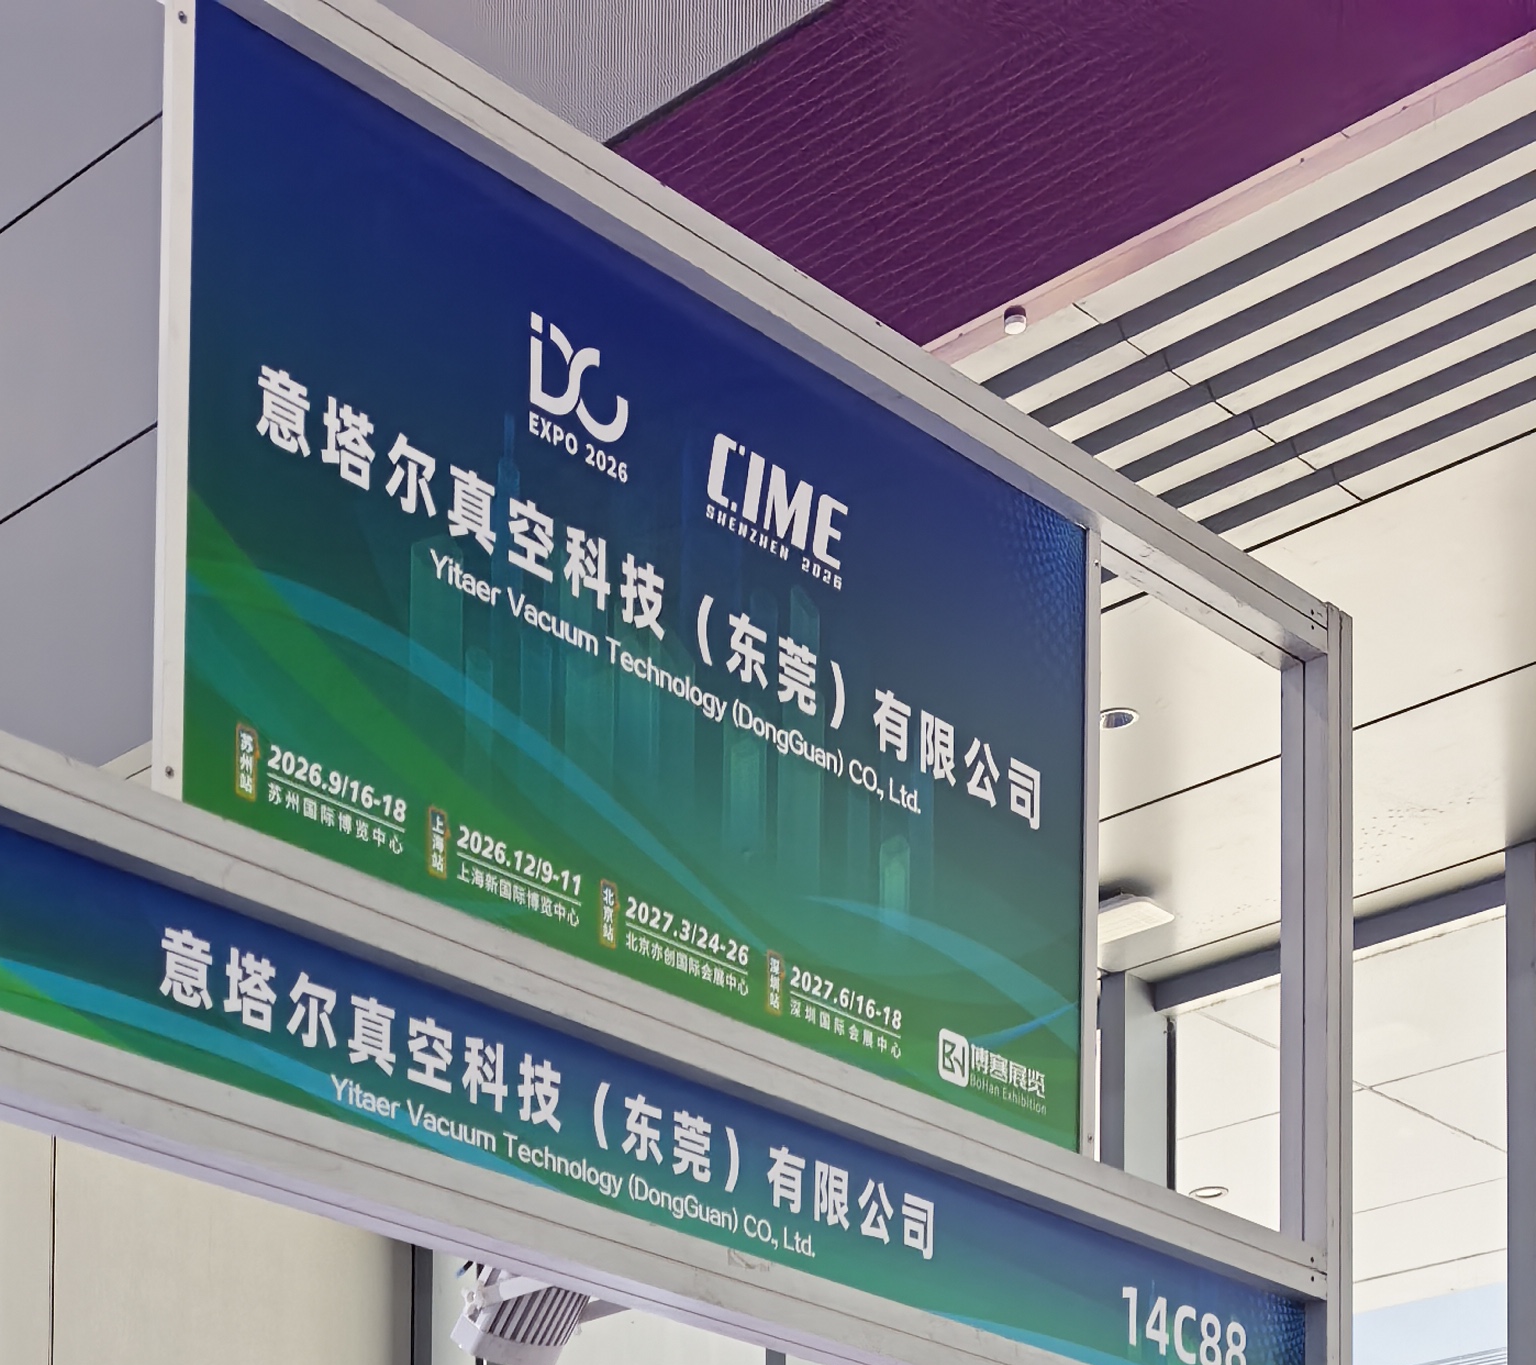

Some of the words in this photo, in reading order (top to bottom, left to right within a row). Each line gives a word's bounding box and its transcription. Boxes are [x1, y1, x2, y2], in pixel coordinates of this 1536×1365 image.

[528, 411, 578, 456] EXPO
[584, 441, 629, 484] 2026
[706, 432, 850, 571] CIME
[705, 504, 792, 562] SHENZHEN
[800, 559, 844, 590] 2026
[256, 363, 1043, 831] 意塔尔真空科技（东莞）有限公司
[429, 548, 503, 605] Yitaer
[510, 598, 599, 655] Vacuum
[606, 638, 728, 724] Technology
[732, 699, 844, 774] (DongGuan)
[889, 778, 923, 816] Ltd.
[267, 745, 407, 823] 2026.9/16-18
[267, 781, 404, 855] 苏州国际博览中心
[457, 825, 582, 896] 2026.12/9-11
[457, 862, 580, 928] 上海新国际博览中心
[625, 895, 749, 966] 2027.3/24-26
[625, 931, 749, 997] 北京亦创国际会展中心
[790, 965, 902, 1030] 2027.6/16-18
[790, 999, 902, 1059] 深圳国际会展中心
[160, 926, 937, 1261] 意塔尔真空科技（东莞）有限公司
[330, 1074, 401, 1122] Yitaer
[406, 1102, 497, 1154] Vacuum
[506, 1135, 623, 1200] Technology
[627, 1173, 740, 1234] (DongGuan)
[783, 1229, 817, 1258] Ltd.
